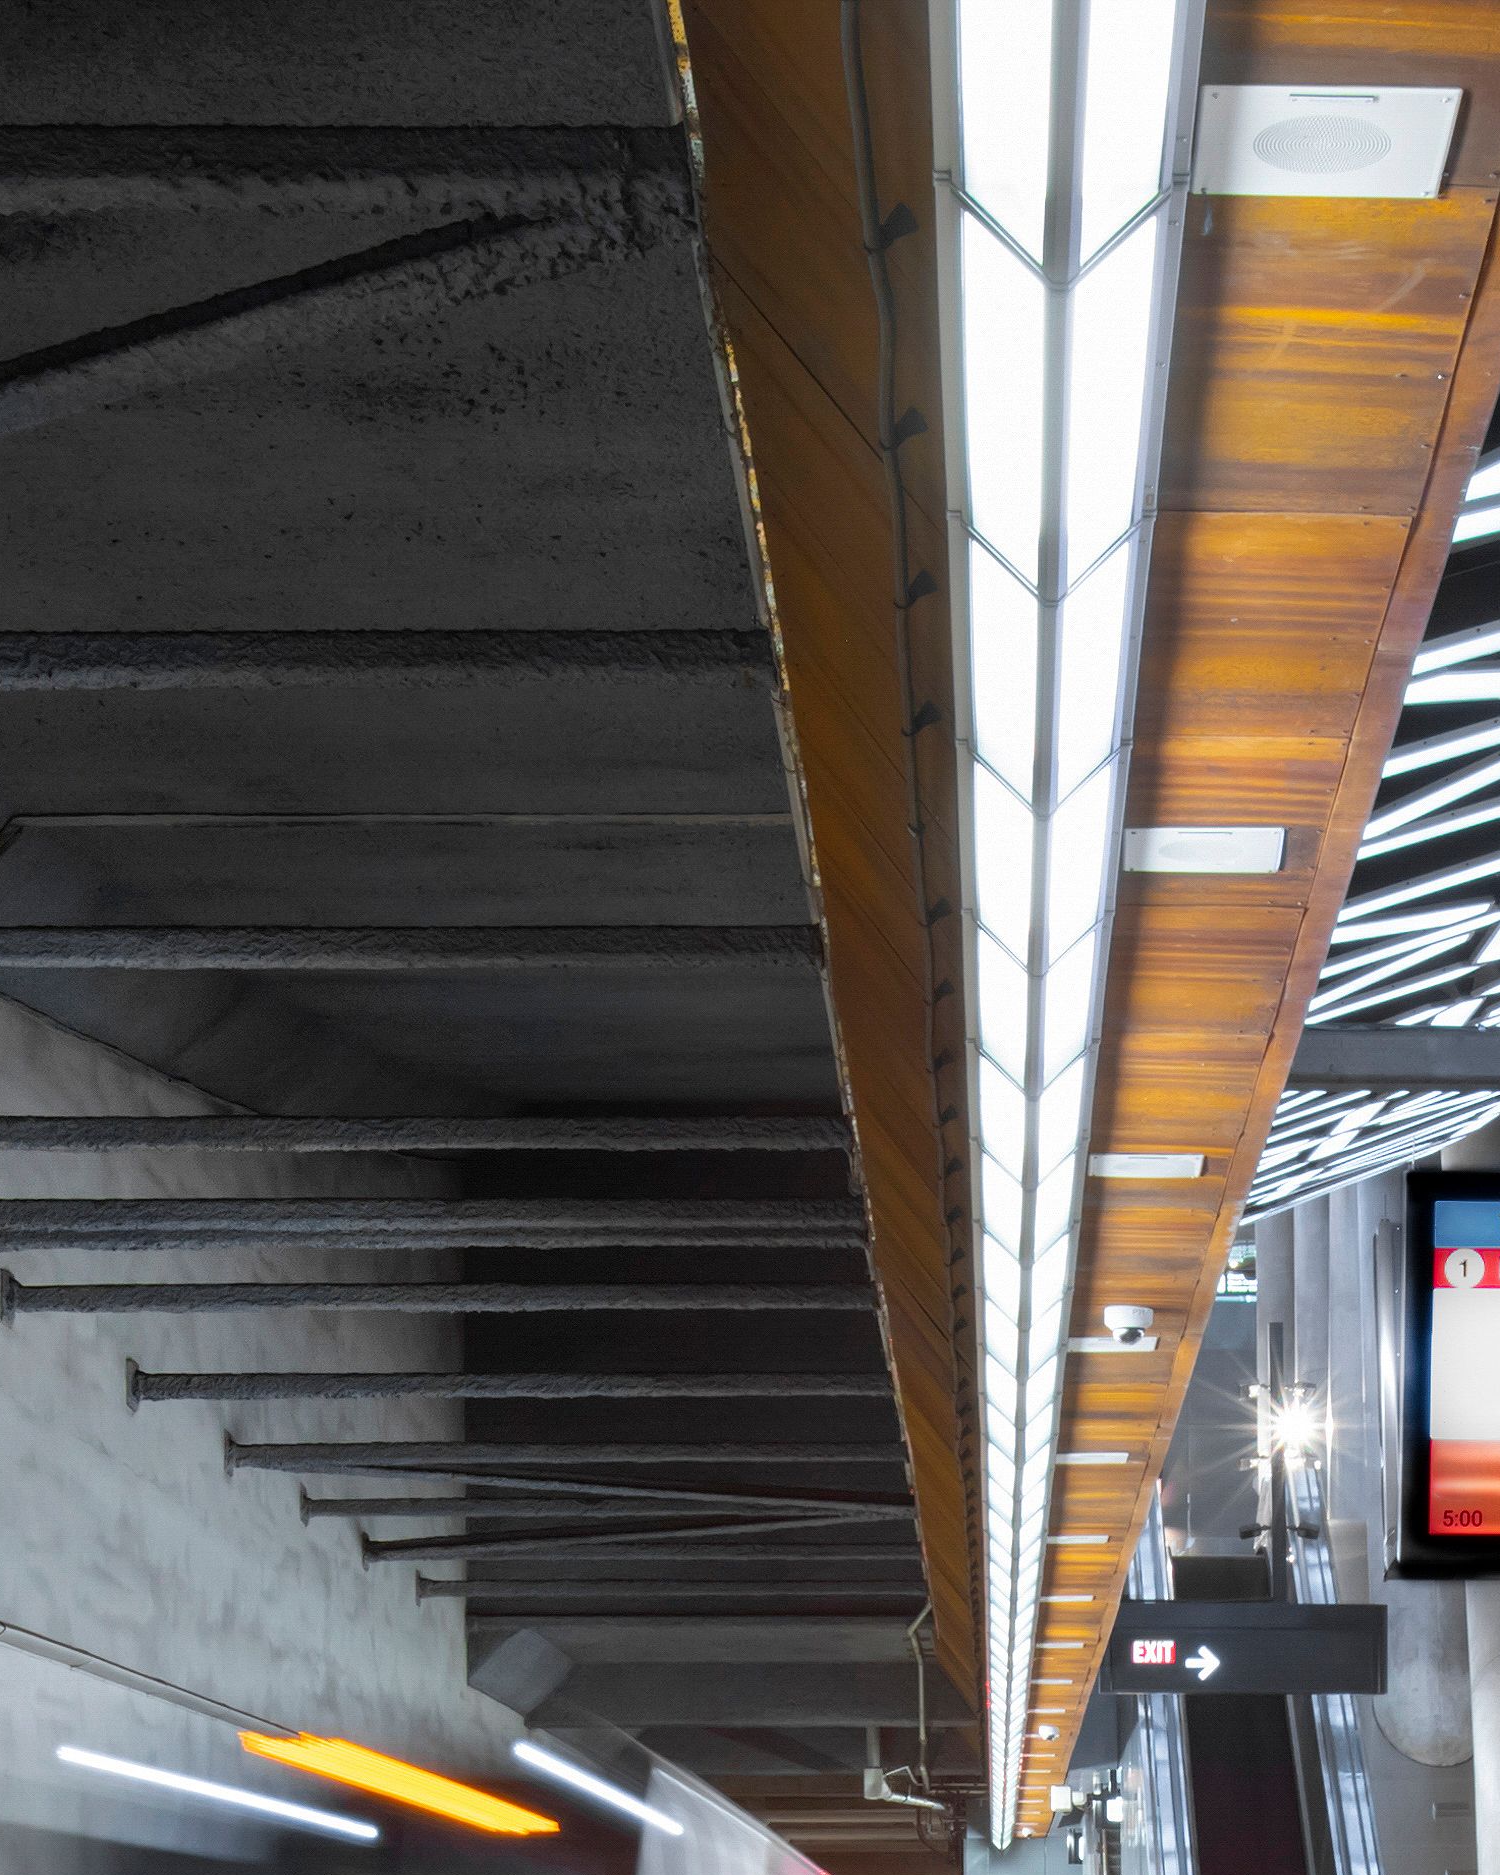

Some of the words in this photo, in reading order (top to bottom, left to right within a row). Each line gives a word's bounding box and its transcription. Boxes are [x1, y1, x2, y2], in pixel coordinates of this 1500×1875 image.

[1458, 1259, 1468, 1278] 1
[1443, 1510, 1483, 1527] 5:00
[1132, 1640, 1175, 1664] EXIT
